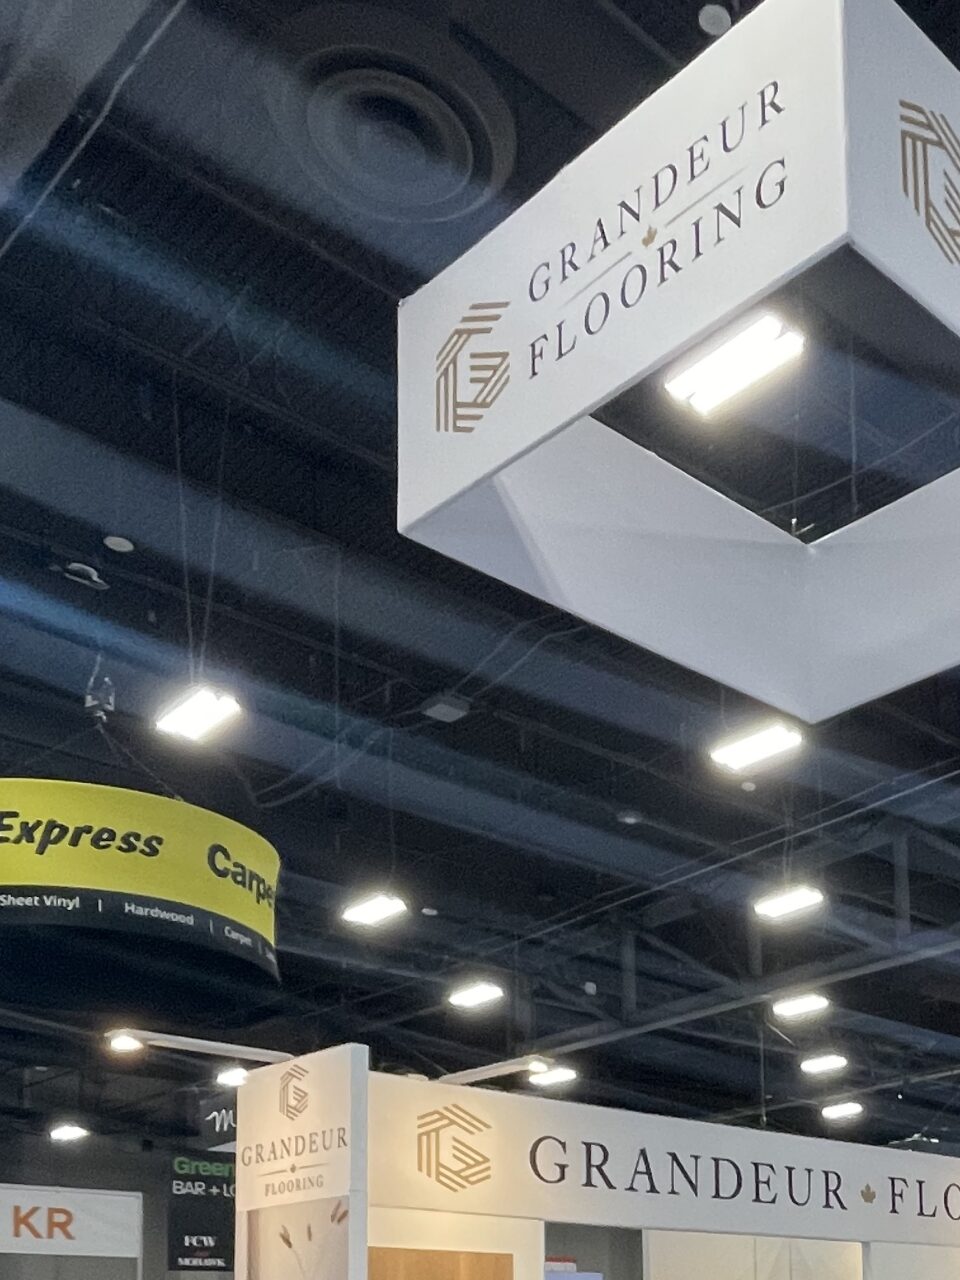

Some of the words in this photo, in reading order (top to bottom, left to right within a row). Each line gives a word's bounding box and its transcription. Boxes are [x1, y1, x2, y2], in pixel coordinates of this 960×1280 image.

[528, 80, 786, 303] GRANDEUR
[528, 157, 788, 380] FLOORING
[0, 811, 164, 855] Express
[0, 894, 39, 908] Sheet
[43, 895, 80, 909] Vinyl
[124, 902, 195, 925] Hardwood
[241, 1127, 348, 1167] GRANDEUR
[172, 1180, 205, 1196] BAR
[264, 1174, 324, 1197] FLOORING
[529, 1135, 848, 1211] GRANDEUR
[12, 1205, 76, 1240] KR
